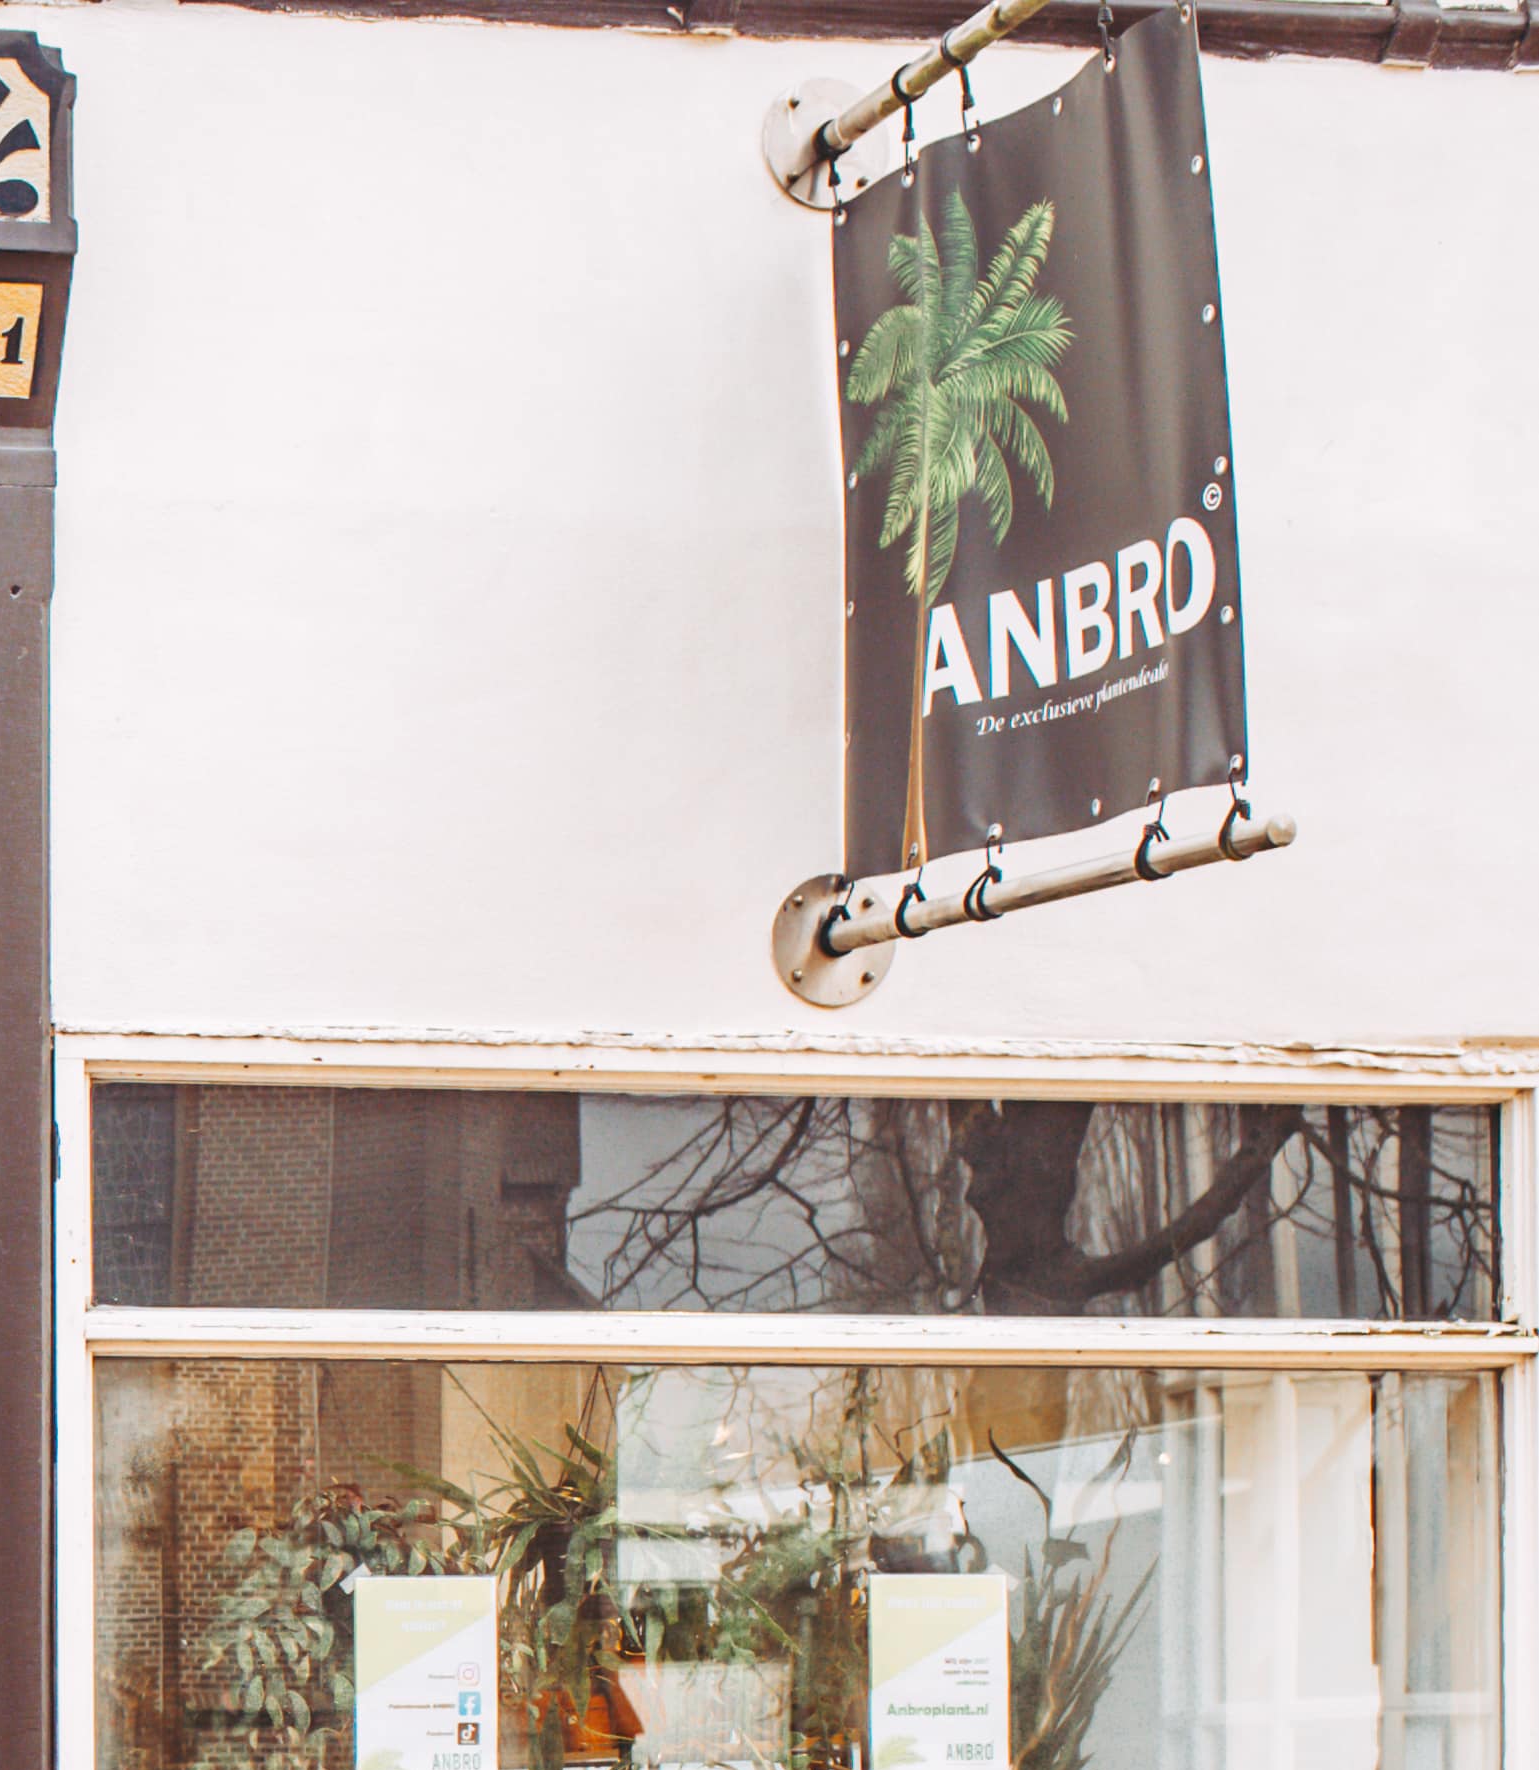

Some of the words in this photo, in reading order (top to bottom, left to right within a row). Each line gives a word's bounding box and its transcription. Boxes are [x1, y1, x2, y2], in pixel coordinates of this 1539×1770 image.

[923, 517, 1217, 718] ANBRO
[976, 715, 1005, 736] De
[1009, 692, 1095, 729] exclusieve
[946, 1743, 995, 1762] ANBRO
